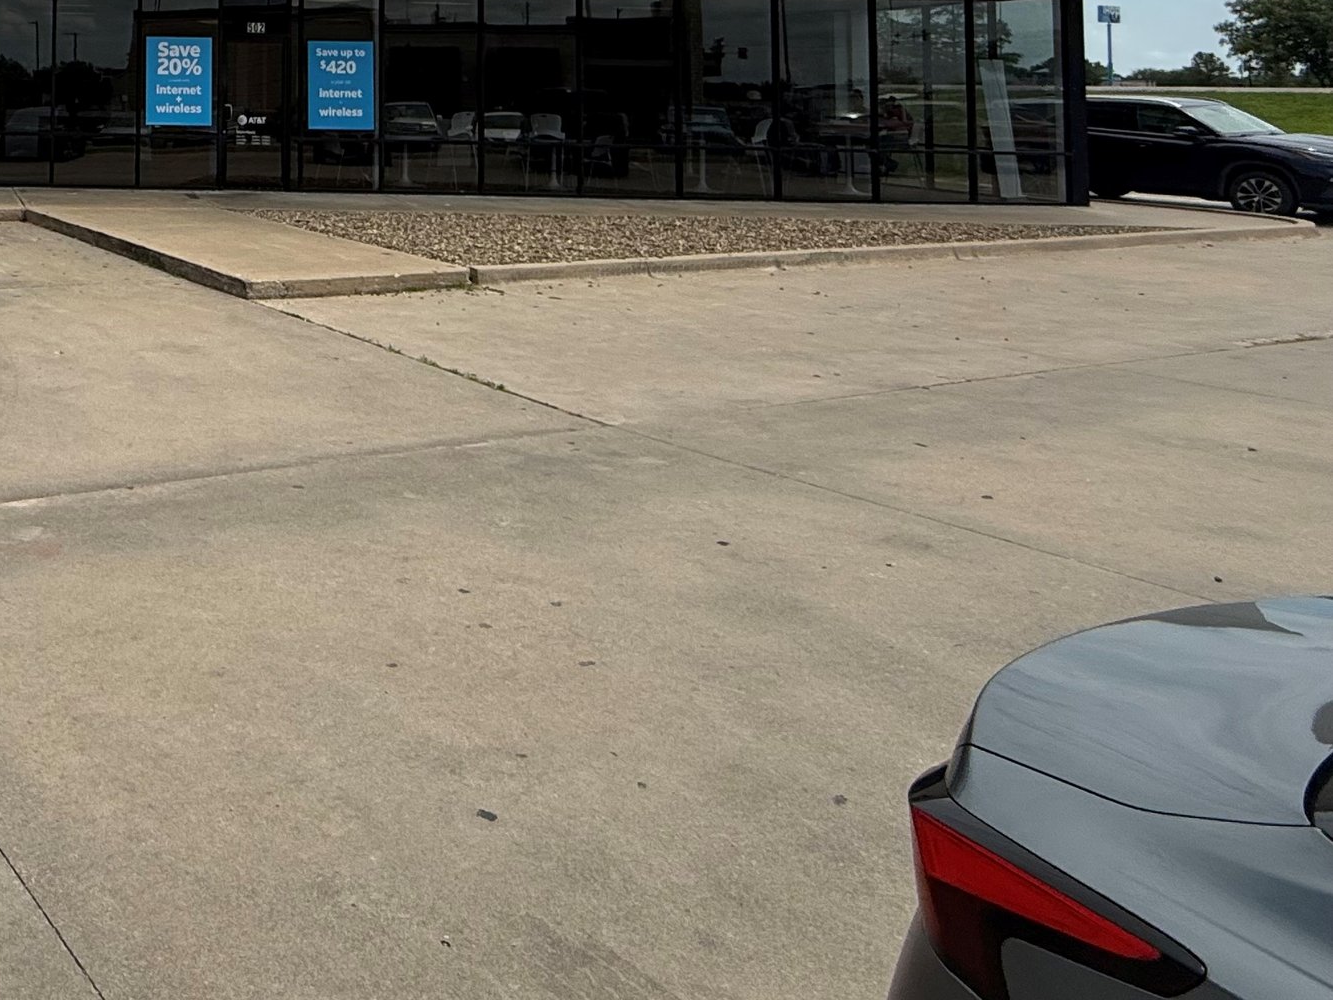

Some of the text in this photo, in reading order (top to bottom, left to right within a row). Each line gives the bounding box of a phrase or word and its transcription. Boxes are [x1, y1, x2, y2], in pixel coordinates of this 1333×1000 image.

[247, 22, 266, 34] 502
[157, 41, 201, 57] Save
[315, 47, 366, 59] Save up to
[157, 58, 203, 75] 20%
[320, 60, 357, 75] $420
[156, 84, 203, 95] internet
[156, 103, 203, 114] wireless
[318, 107, 364, 117] wireless
